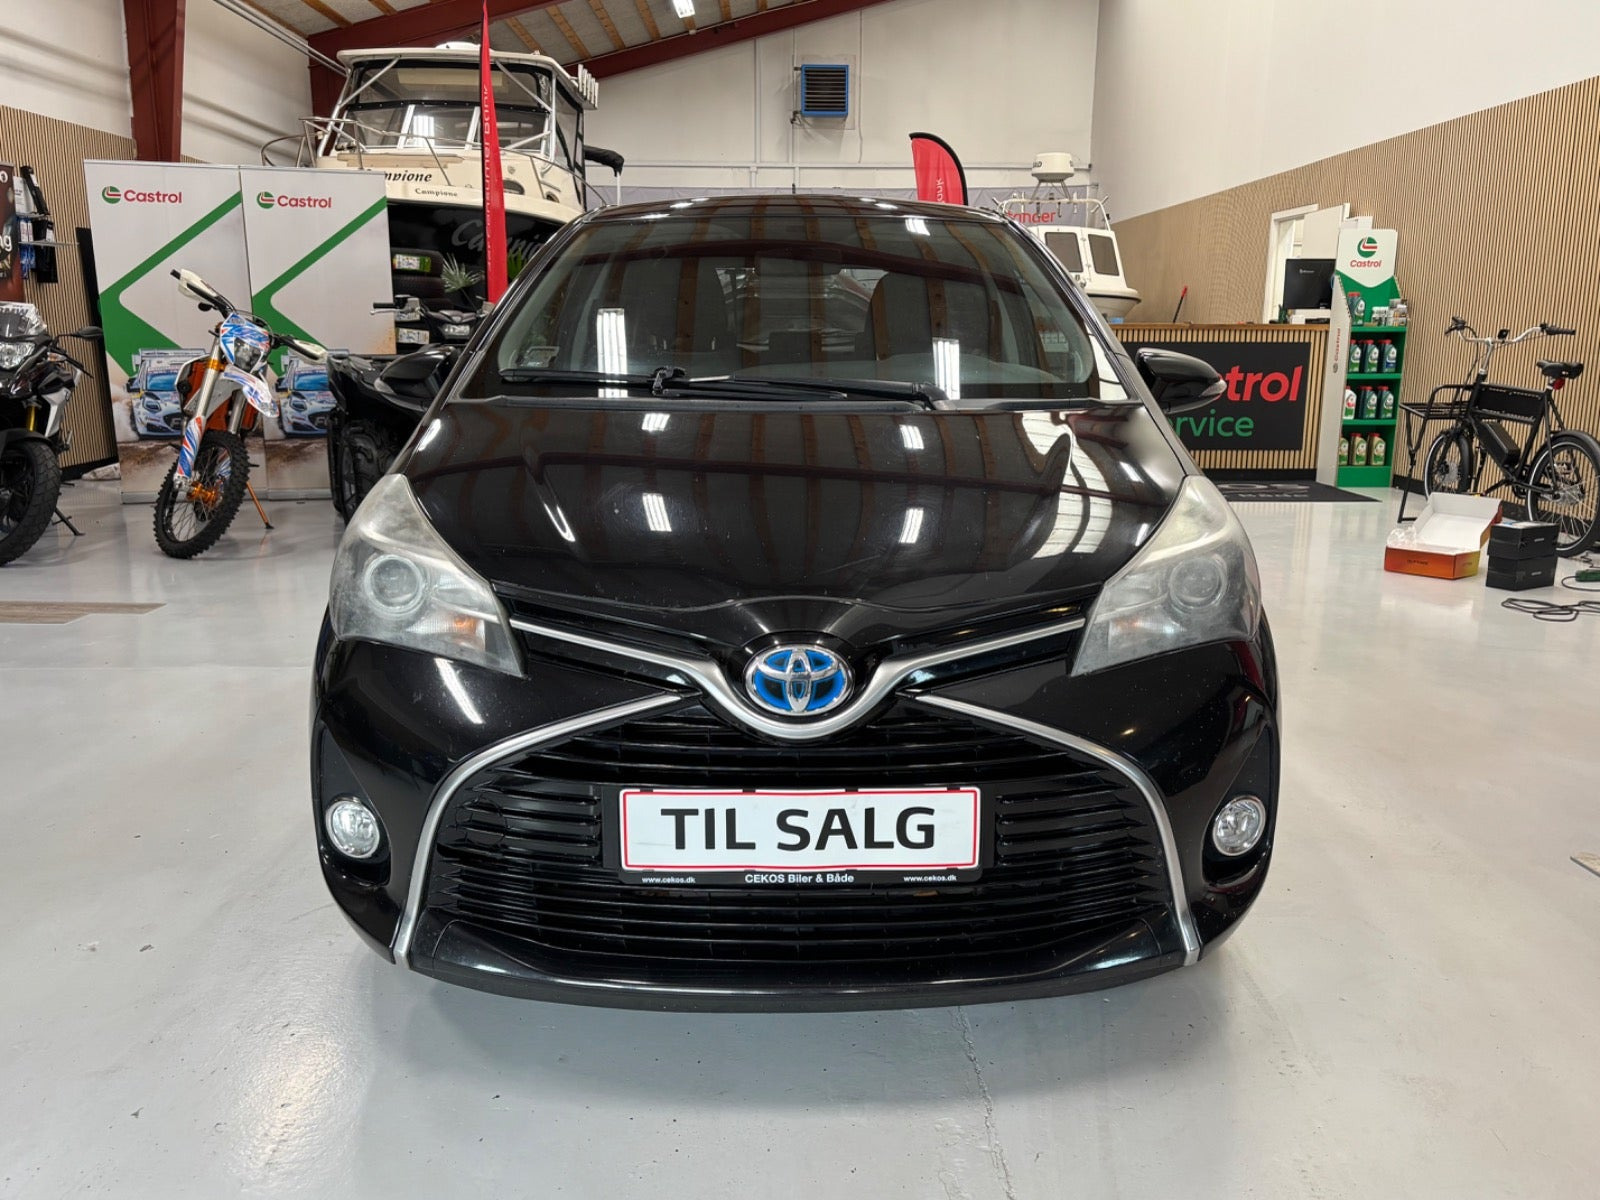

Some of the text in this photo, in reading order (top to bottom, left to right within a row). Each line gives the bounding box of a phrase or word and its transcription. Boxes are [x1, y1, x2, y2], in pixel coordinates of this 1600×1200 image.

[124, 189, 182, 204] Castrol
[415, 188, 458, 198] Campione
[277, 195, 332, 209] Castrol
[1350, 260, 1382, 269] Castrol
[1215, 364, 1303, 402] trol
[1168, 409, 1255, 437] rvice
[661, 806, 935, 851] TIL SALG
[641, 876, 696, 884] www.cekos.dk
[744, 873, 855, 884] CEKOS Biler & Både
